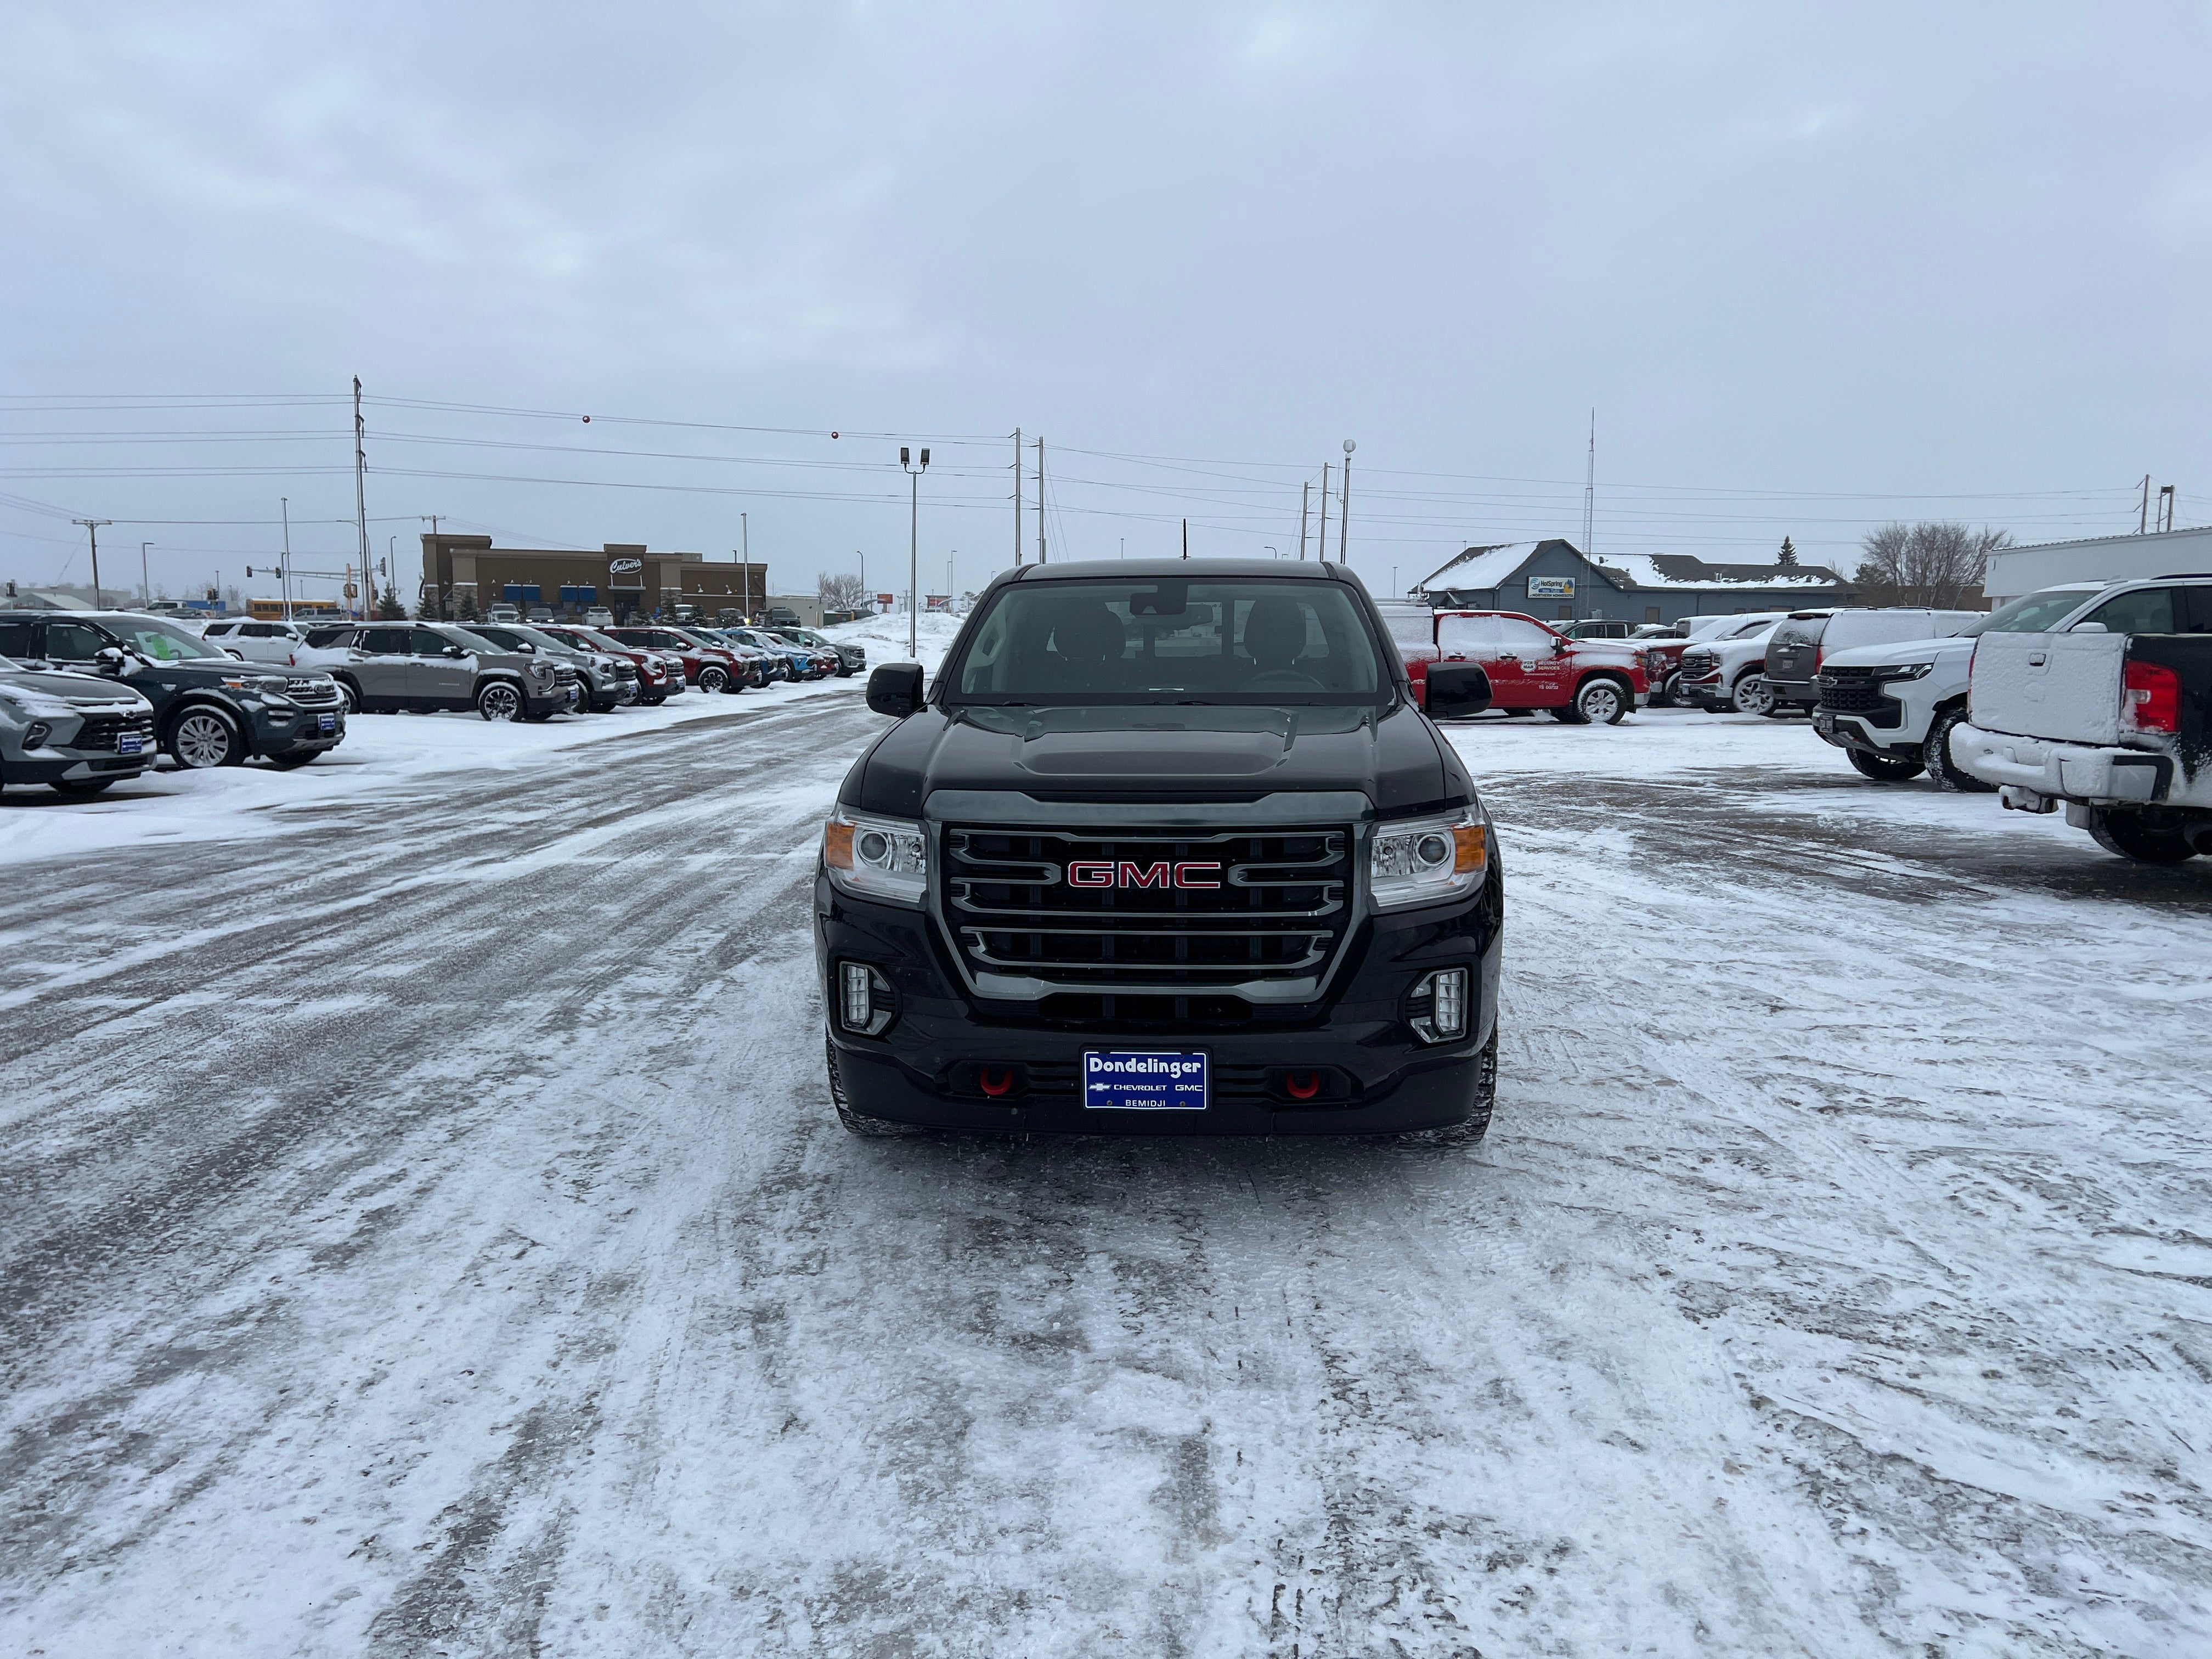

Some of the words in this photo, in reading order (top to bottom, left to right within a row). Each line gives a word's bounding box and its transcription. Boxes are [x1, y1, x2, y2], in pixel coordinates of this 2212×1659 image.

[610, 558, 642, 573] Culver's
[1068, 861, 1221, 888] GMC
[1090, 1058, 1201, 1079] Dondelinger
